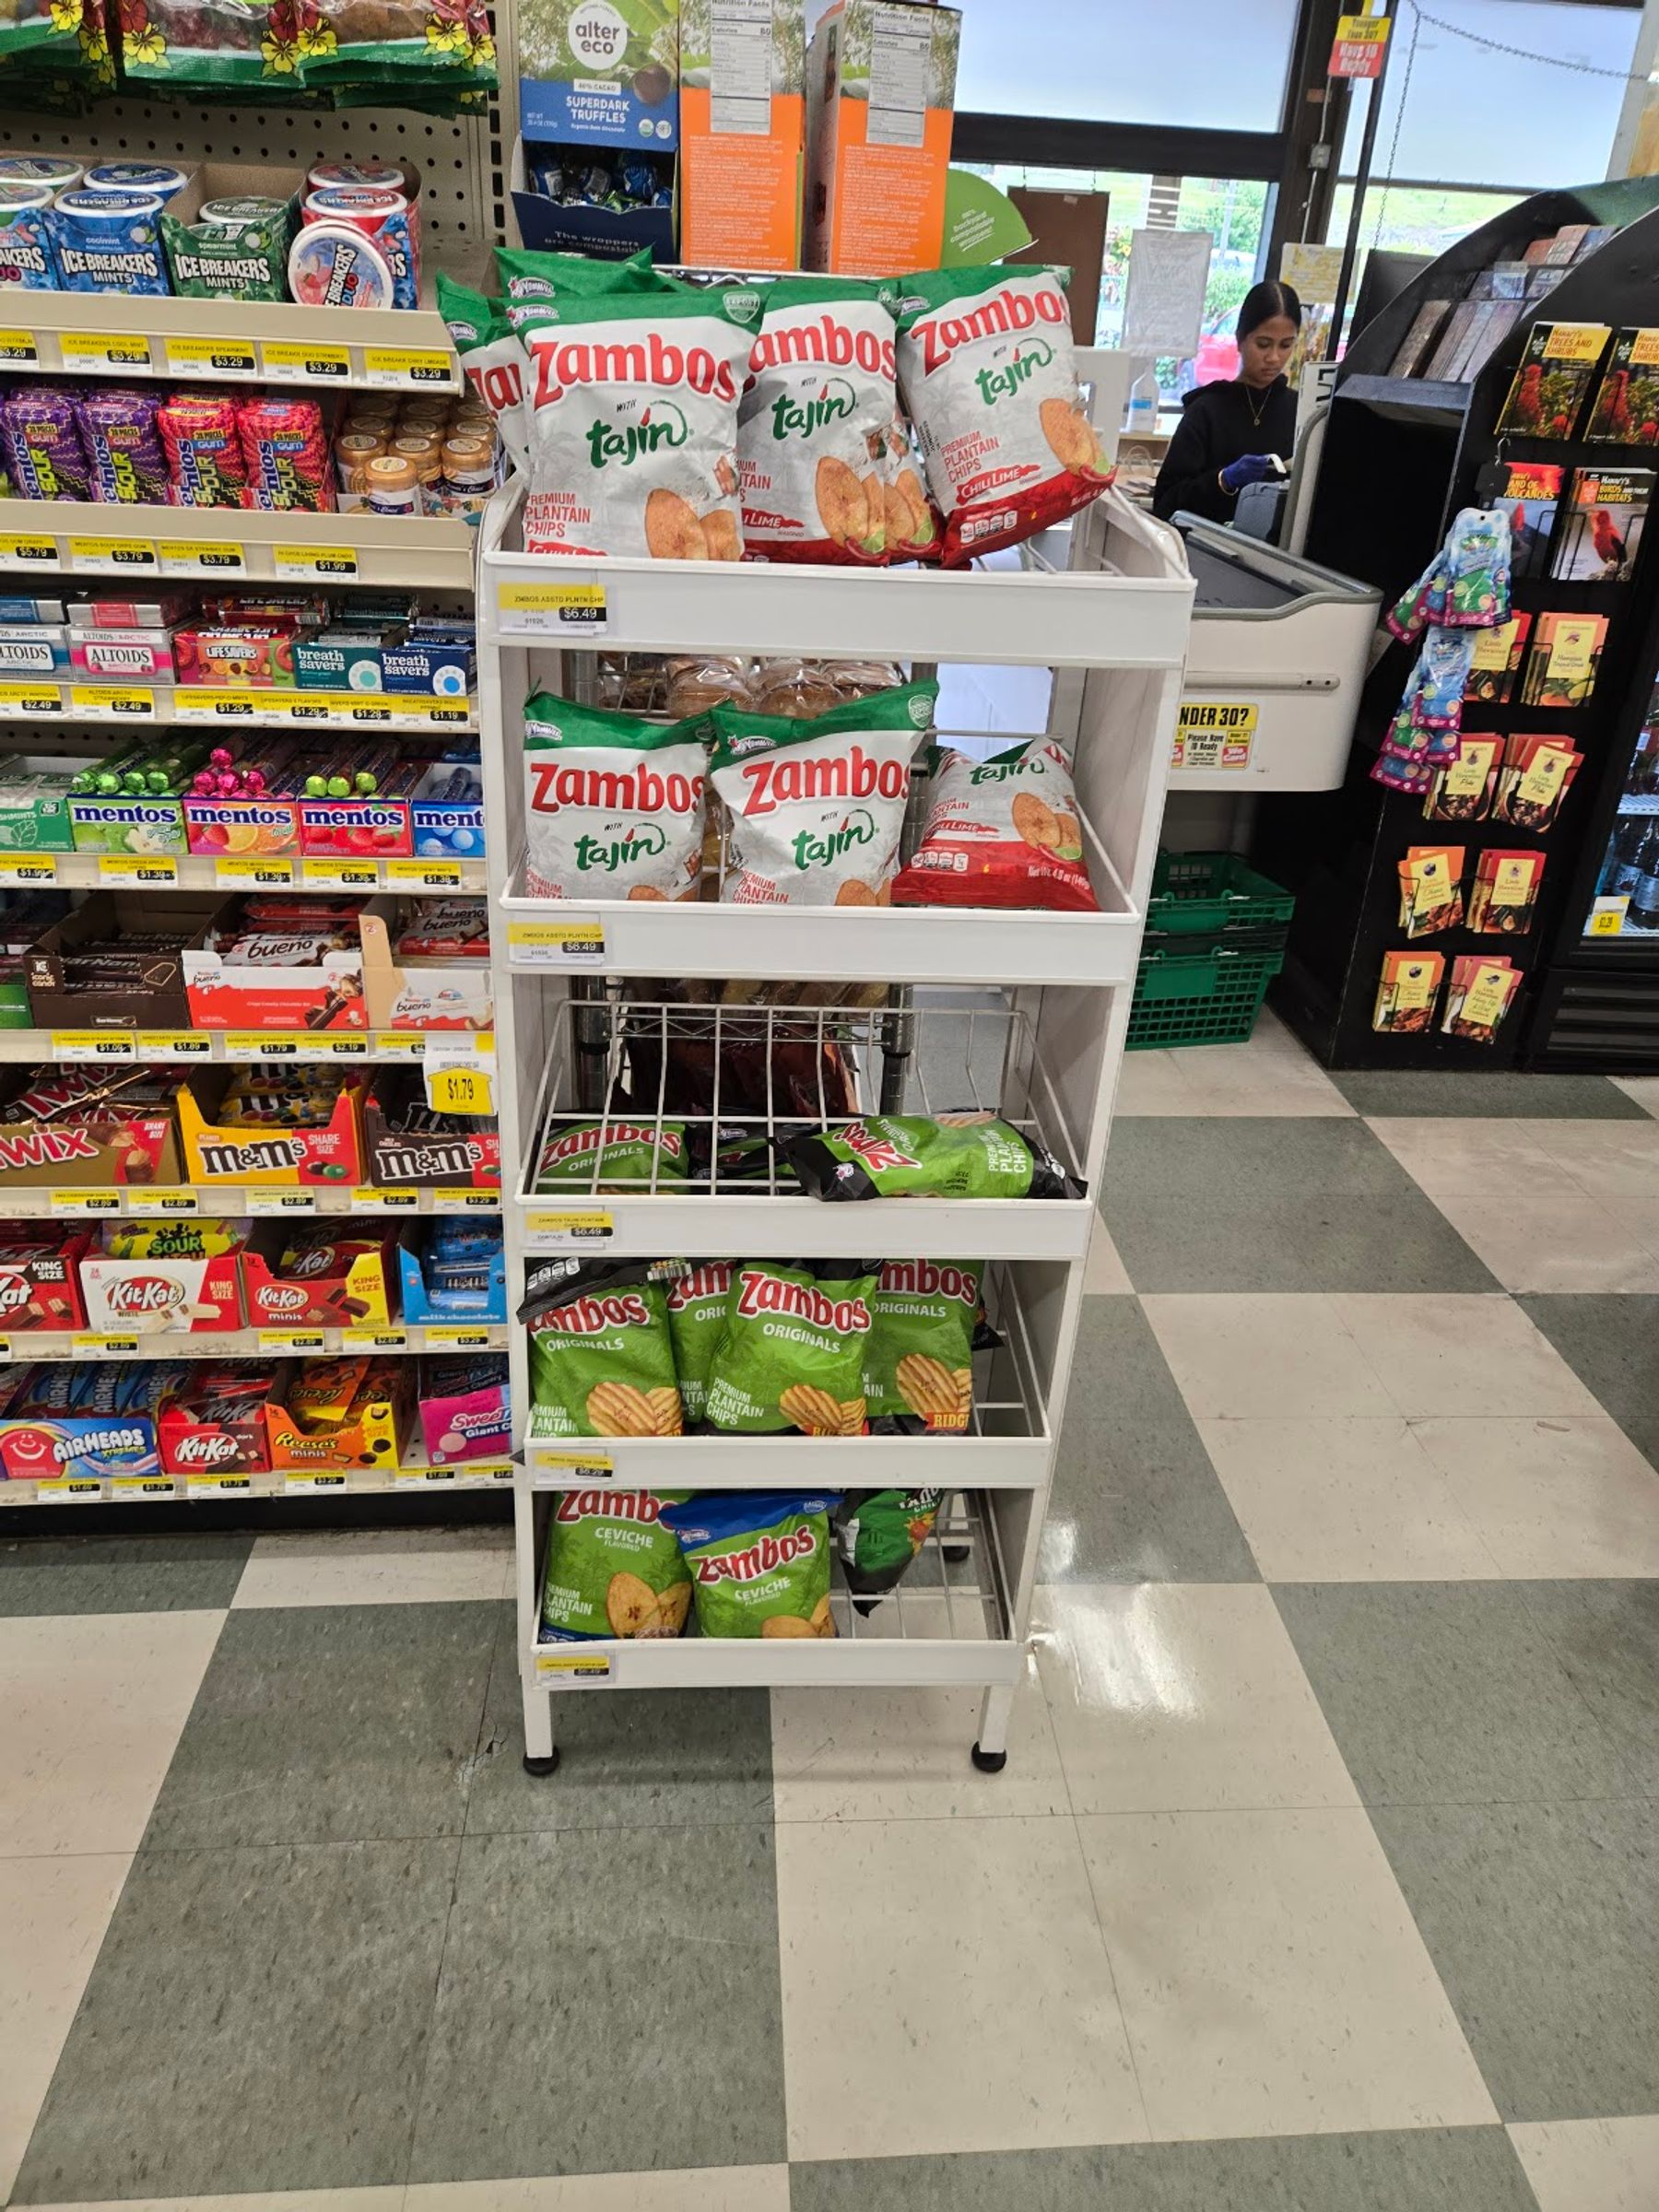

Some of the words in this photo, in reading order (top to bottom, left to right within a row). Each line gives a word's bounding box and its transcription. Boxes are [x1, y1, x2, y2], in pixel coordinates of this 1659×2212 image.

[575, 21, 619, 40] alter
[582, 40, 614, 54] eco
[566, 96, 629, 112] SUPERDARK
[571, 109, 626, 124] TRUFFLES
[555, 230, 577, 240] The
[582, 234, 639, 246] wrappers
[0, 247, 45, 272] AKERS
[61, 248, 86, 275] ICE
[86, 250, 158, 276] BREAKERS
[174, 254, 200, 279] ICE
[200, 255, 270, 281] BREAKERS
[327, 244, 356, 306] BREAKERS
[93, 272, 133, 283] MINTS
[206, 277, 245, 288] MINTS
[345, 273, 359, 305] DUO
[748, 315, 896, 382] ambos
[1549, 337, 1576, 347] TREES
[1577, 339, 1593, 347] AND
[112, 350, 139, 361] $3.29
[1545, 347, 1578, 356] SHRUBS
[216, 356, 242, 367] $3.29
[309, 362, 337, 373] $3.29
[413, 369, 441, 379] $3.29
[530, 334, 736, 412] Zambos
[31, 434, 58, 443] GUM
[113, 437, 140, 445] GUM
[197, 440, 225, 449] GUM
[276, 441, 303, 451] GUM
[940, 430, 981, 456] PREMIUM
[944, 436, 999, 471] PLANTAIN
[12, 431, 44, 500] entos
[30, 449, 58, 492] SOUR
[92, 434, 121, 504] entos
[947, 458, 982, 483] CHIPS
[112, 452, 137, 500] SOUR
[194, 455, 220, 504] SOUR
[273, 457, 297, 506] SOUR
[992, 467, 1021, 488] LIME
[1599, 485, 1622, 493] BIRDS
[1597, 493, 1632, 503] HABITATS
[525, 507, 591, 522] PLANTAIN
[750, 512, 782, 527] LIME
[525, 521, 566, 537] CHIPS
[114, 551, 143, 561] $3.79
[202, 554, 229, 564] $3.79
[564, 607, 597, 619] $6.49
[83, 632, 114, 641] ALTOIDS
[0, 645, 49, 660] LTOIDS
[91, 648, 150, 663] ALTOIDS
[297, 648, 345, 662] breath
[382, 653, 429, 666] breath
[300, 659, 345, 671] savers
[384, 665, 430, 677] savers
[25, 700, 52, 710] $2.49
[114, 701, 141, 711] $2.49
[218, 703, 244, 712] $1.29
[432, 712, 458, 721] $1.19
[1179, 707, 1218, 725] NDER
[1218, 708, 1250, 726] 30?
[1187, 734, 1209, 742] Please
[1209, 734, 1224, 742] Have
[1191, 743, 1198, 751] ID
[1199, 743, 1218, 752] Ready
[531, 762, 705, 813] Zambos
[74, 806, 177, 823] mentos
[190, 806, 291, 824] mentos
[305, 810, 403, 825] mentos
[417, 811, 483, 827] ment
[950, 820, 979, 831] LIME
[422, 920, 471, 931] bueno
[247, 939, 313, 959] bueno
[567, 943, 596, 951] $6.49
[193, 974, 221, 984] bueno
[396, 1001, 431, 1012] bueno
[448, 1078, 474, 1100] $1.79
[308, 1134, 341, 1145] SHARE
[316, 1145, 335, 1154] SIZE
[539, 1124, 681, 1173] Zambos
[150, 1236, 202, 1254] SOUR
[32, 1261, 63, 1271] KING
[38, 1271, 65, 1280] SIZE
[352, 1276, 381, 1285] KING
[877, 1259, 976, 1305] mbos
[209, 1281, 233, 1290] KING
[354, 1284, 381, 1293] SIZE
[111, 1282, 181, 1310] KitKat
[212, 1290, 233, 1300] SIZE
[257, 1287, 306, 1309] KitKat
[737, 1272, 871, 1332] Zambos
[268, 1312, 302, 1321] minis
[547, 1338, 625, 1351] ORIGINALS
[763, 1324, 841, 1353] ORIGINALS
[714, 1377, 751, 1404] PREMIUM
[710, 1389, 764, 1418] PLANTAIN
[706, 1401, 738, 1425] CHIPS
[276, 1431, 339, 1449] Reese's
[465, 1427, 499, 1438] Giant
[53, 1429, 145, 1463] AIRHEADS
[177, 1437, 239, 1462] KitKat
[290, 1449, 326, 1458] minis
[556, 1489, 677, 1530] Zamb
[594, 1527, 654, 1548] CEVICHE
[604, 1540, 640, 1552] FLAVORED
[692, 1525, 815, 1583] Zambos
[735, 1576, 792, 1602] CEVICHE
[546, 1597, 593, 1616] LANTAIN
